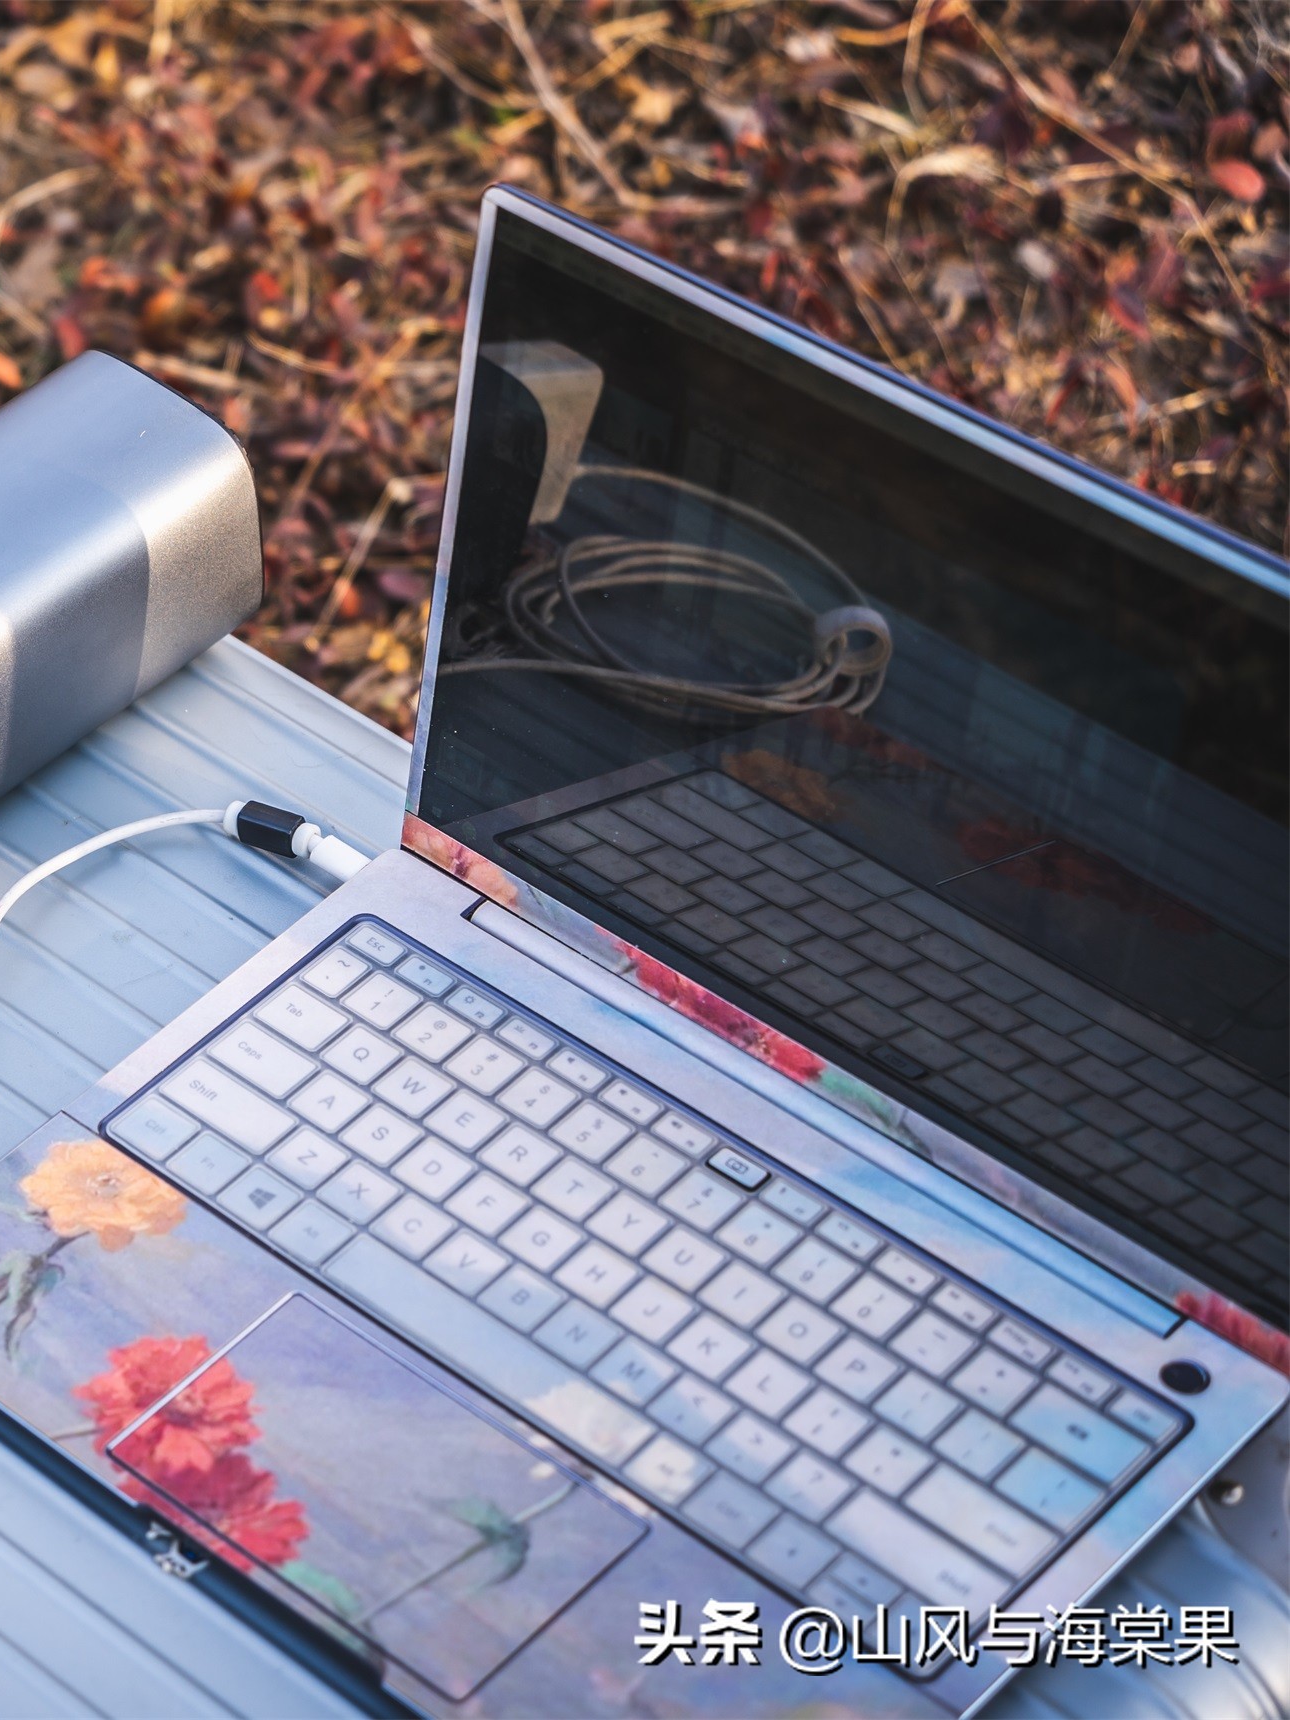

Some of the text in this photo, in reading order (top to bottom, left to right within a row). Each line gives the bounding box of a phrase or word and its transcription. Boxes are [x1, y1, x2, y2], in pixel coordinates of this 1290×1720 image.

[366, 936, 385, 952] Esc
[286, 1003, 302, 1017] Tab
[418, 1032, 432, 1043] 2
[238, 1041, 262, 1060] Caps
[353, 1047, 370, 1062] Q
[470, 1065, 484, 1076] 3
[189, 1080, 218, 1101] Shift
[402, 1077, 426, 1095] W
[318, 1096, 335, 1109] A
[524, 1099, 536, 1107] 4
[145, 1119, 166, 1135] Ctrl
[455, 1112, 475, 1127] E
[371, 1127, 389, 1141] S
[576, 1131, 591, 1142] 5
[297, 1150, 318, 1165] Z
[508, 1145, 528, 1162] R
[422, 1160, 442, 1175] D
[631, 1165, 645, 1176] 6
[348, 1183, 369, 1200] X
[567, 1179, 584, 1194] T
[477, 1196, 495, 1207] F
[687, 1199, 701, 1209] 7
[403, 1218, 422, 1234] C
[623, 1214, 639, 1228] Y
[531, 1232, 551, 1246] G
[459, 1253, 477, 1268] V
[674, 1249, 694, 1266] U
[585, 1266, 606, 1282] H
[800, 1271, 814, 1282] 9
[510, 1289, 530, 1305] B
[643, 1305, 661, 1317] J
[566, 1325, 587, 1343] N
[788, 1322, 809, 1339] O
[698, 1338, 718, 1355] K
[621, 1361, 645, 1381] M
[845, 1359, 866, 1372] P
[757, 1375, 770, 1392] L
